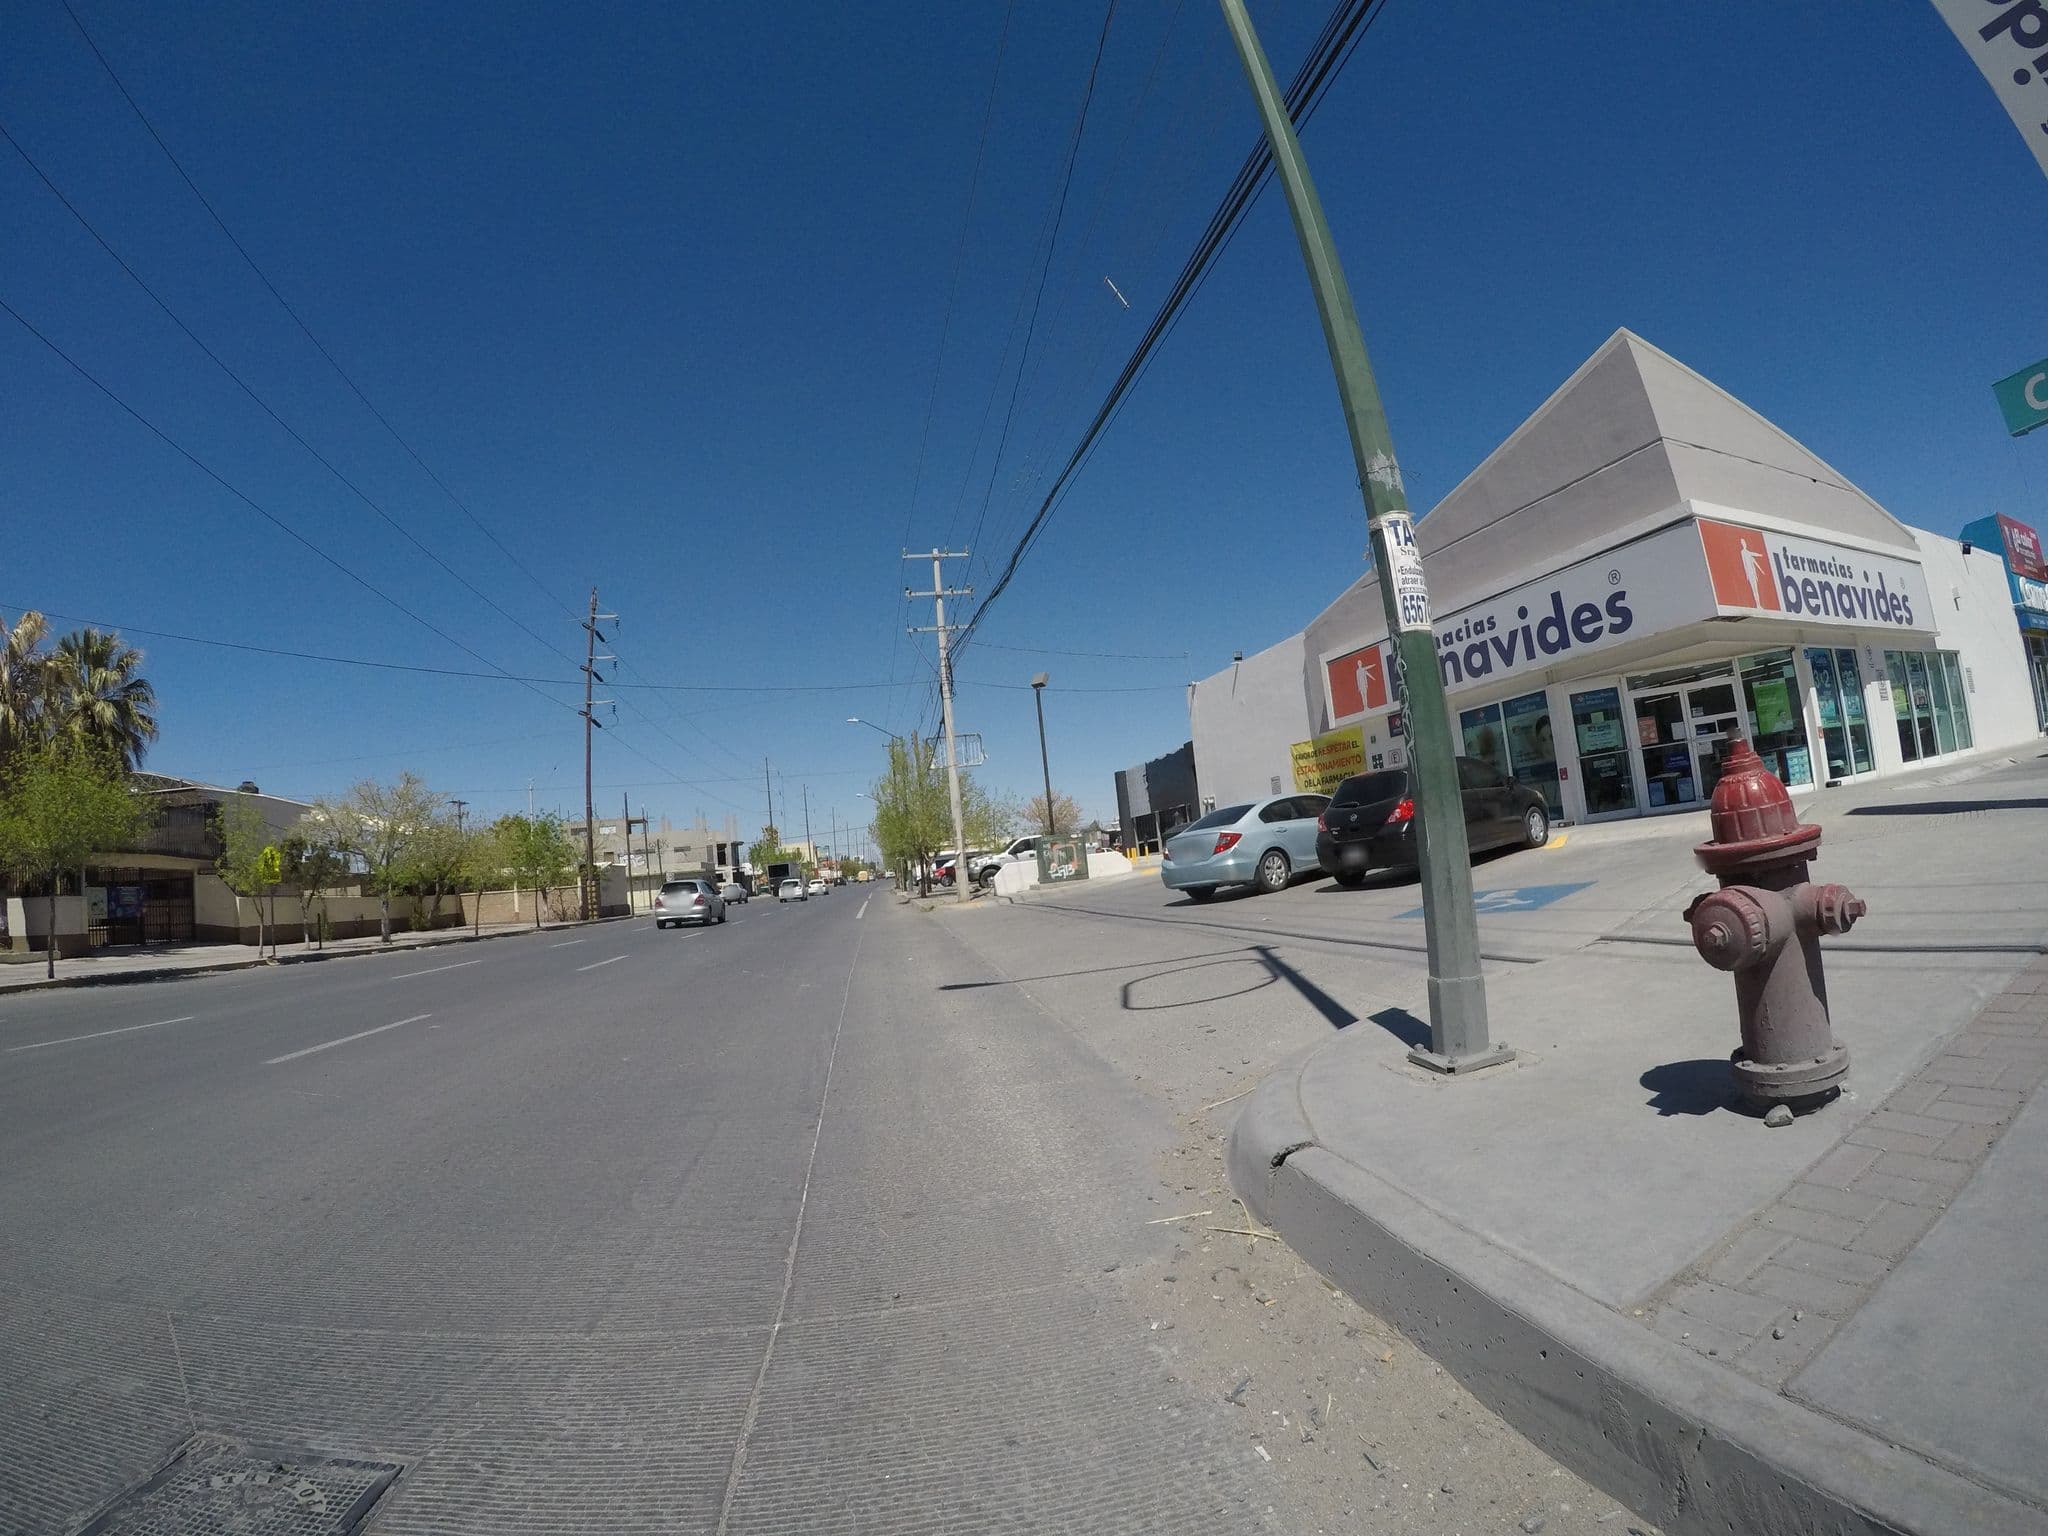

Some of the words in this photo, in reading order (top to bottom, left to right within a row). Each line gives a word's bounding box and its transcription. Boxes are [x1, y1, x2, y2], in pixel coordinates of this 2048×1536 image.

[1387, 519, 1416, 547] TA
[1783, 546, 1853, 579] farmacias
[1773, 552, 1913, 625] benavides
[1402, 594, 1432, 624] 6567
[1386, 590, 1633, 702] navides
[1434, 614, 1497, 649] acias
[1296, 753, 1362, 776] ESTACIONAMIENTO
[1310, 749, 1319, 759] DE
[1318, 741, 1352, 757] RESPETAR
[1351, 740, 1360, 749] EL
[1304, 778, 1313, 788] DE
[1313, 777, 1322, 787] LA
